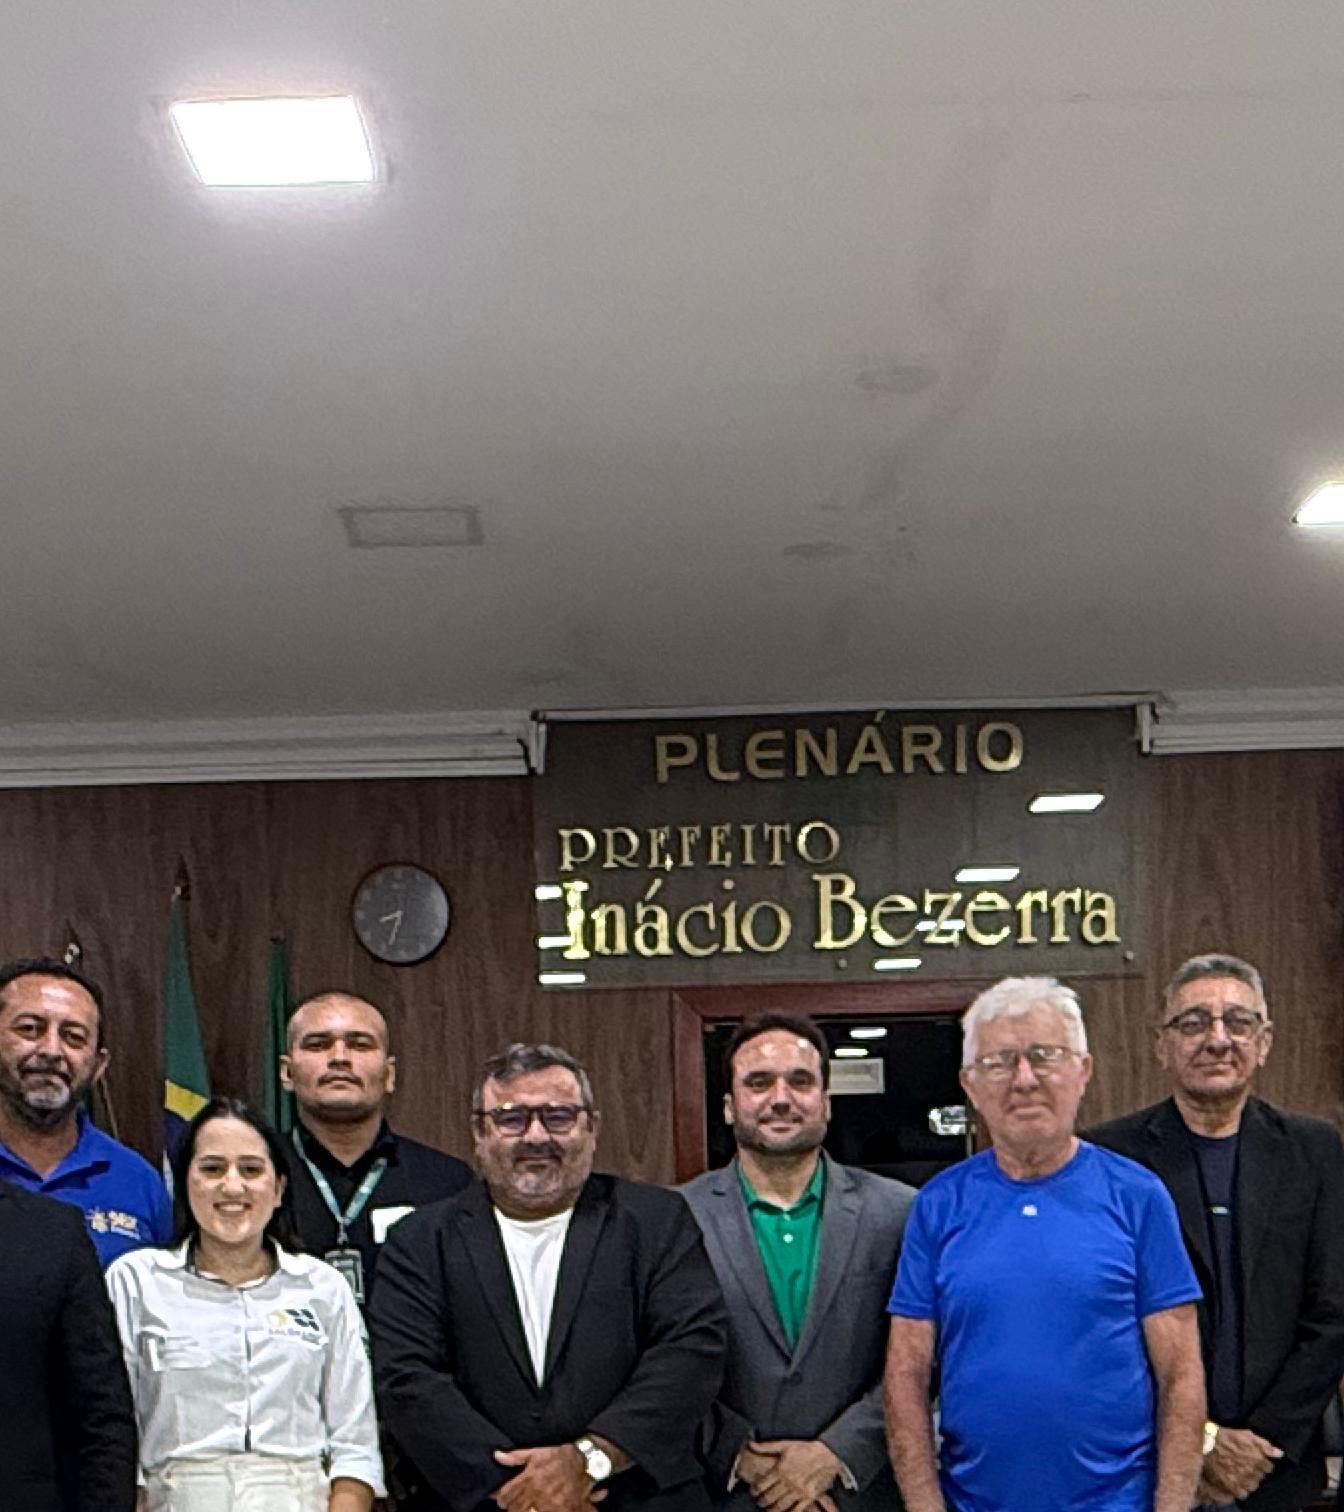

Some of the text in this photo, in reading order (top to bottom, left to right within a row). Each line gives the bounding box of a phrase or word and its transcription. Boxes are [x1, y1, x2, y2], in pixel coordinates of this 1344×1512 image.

[656, 711, 1024, 783] PLENÁRIO
[559, 821, 840, 871] PREFEITO
[563, 873, 1121, 959] Inácio Bezerra
